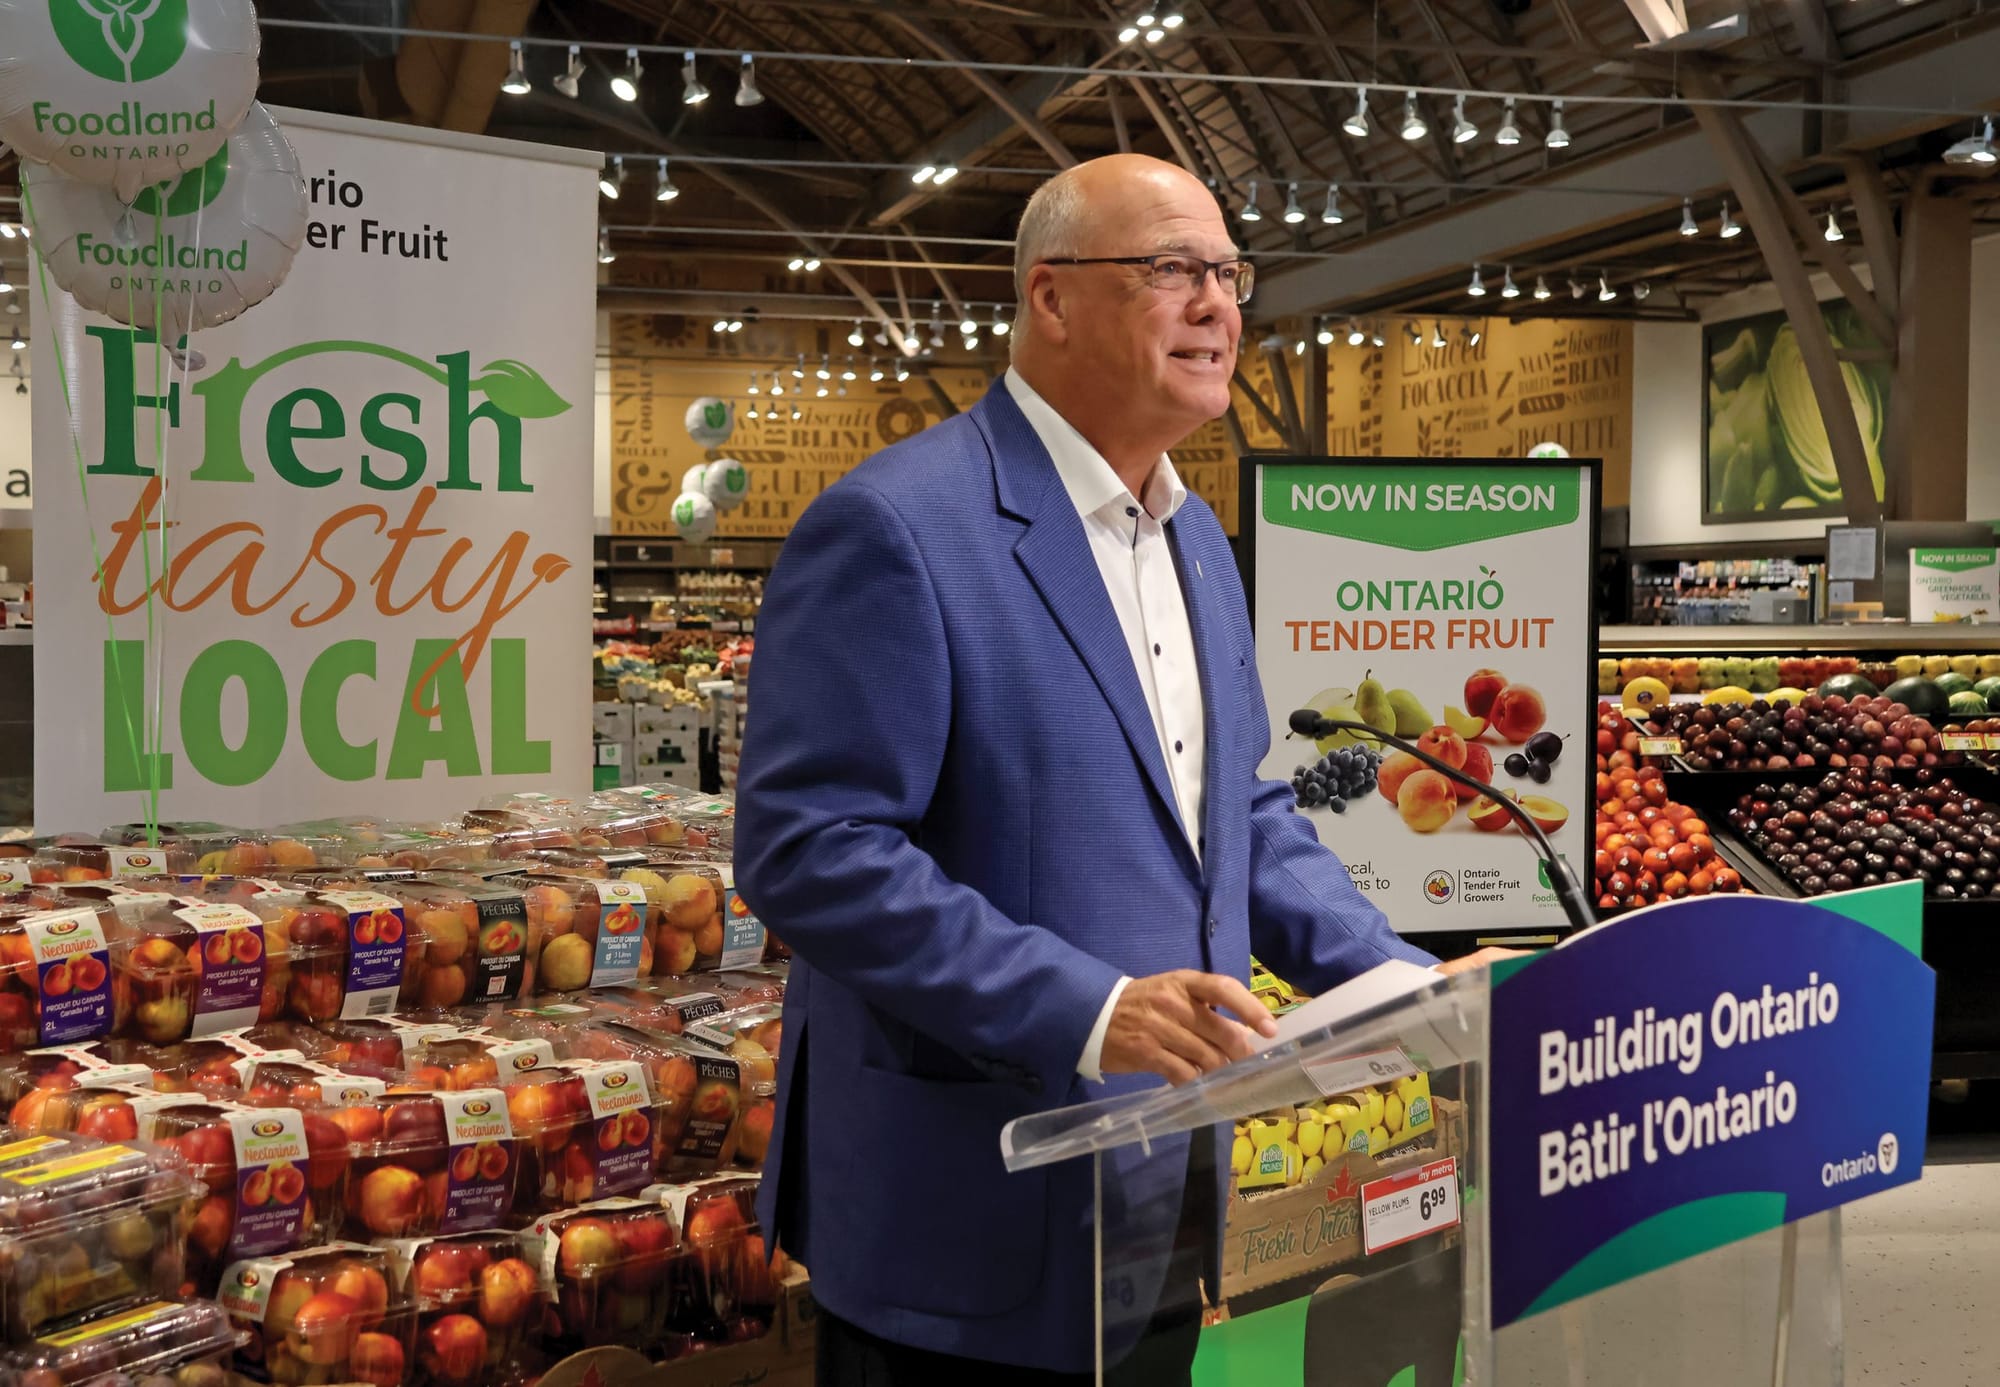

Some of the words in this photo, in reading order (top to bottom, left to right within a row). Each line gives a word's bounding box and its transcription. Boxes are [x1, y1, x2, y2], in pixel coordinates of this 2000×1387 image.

[33, 100, 215, 136] Foodland
[70, 144, 190, 160] ONTARIO
[310, 169, 363, 208] rio
[306, 221, 346, 250] er
[361, 219, 449, 262] Fruit
[76, 233, 248, 272] Foodland
[110, 276, 223, 293] ONTARIO
[1401, 369, 1488, 410] FOCACCIA
[85, 325, 534, 493] Fresh
[1290, 484, 1377, 512] NOW
[1385, 484, 1418, 512] IN
[1425, 484, 1556, 512] SEASON
[1921, 554, 1943, 563] NOW
[1945, 554, 1954, 562] IN
[1956, 553, 1990, 563] SEASON
[1915, 576, 1952, 585] ONTARIO
[1928, 584, 1982, 593] GREENHOUSE
[91, 475, 533, 718] tasty
[1336, 579, 1504, 612] ONTARIO
[1940, 592, 1991, 600] VEGETABLES
[1284, 619, 1436, 651] TENDER
[1446, 618, 1554, 649] FRUIT
[103, 637, 552, 793] LOCAL
[1376, 876, 1391, 890] to
[1463, 868, 1500, 879] Ontario
[1463, 880, 1496, 891] Tender
[1498, 879, 1521, 890] Fruit
[1464, 892, 1505, 903] Growers
[41, 938, 98, 959] Nectarines
[202, 988, 212, 996] 2L
[684, 1003, 721, 1019] PÊCHES
[45, 1021, 57, 1031] 2L
[1539, 1007, 1703, 1096] Building
[1711, 972, 1840, 1049] Ontario
[702, 1061, 736, 1079] PÊCHES
[597, 1093, 644, 1112] Nectarines
[455, 1123, 506, 1138] Nectarines
[1539, 1112, 1636, 1197] Bâtir
[1642, 1071, 1798, 1165] l'Ontario
[244, 1144, 300, 1161] Nectarines
[1419, 1170, 1430, 1181] my
[1432, 1164, 1453, 1177] metro
[1821, 1151, 1877, 1188] Ontario
[1368, 1203, 1391, 1217] YELLOW
[1392, 1196, 1410, 1209] PLUMS
[1240, 1219, 1296, 1277] Fresh
